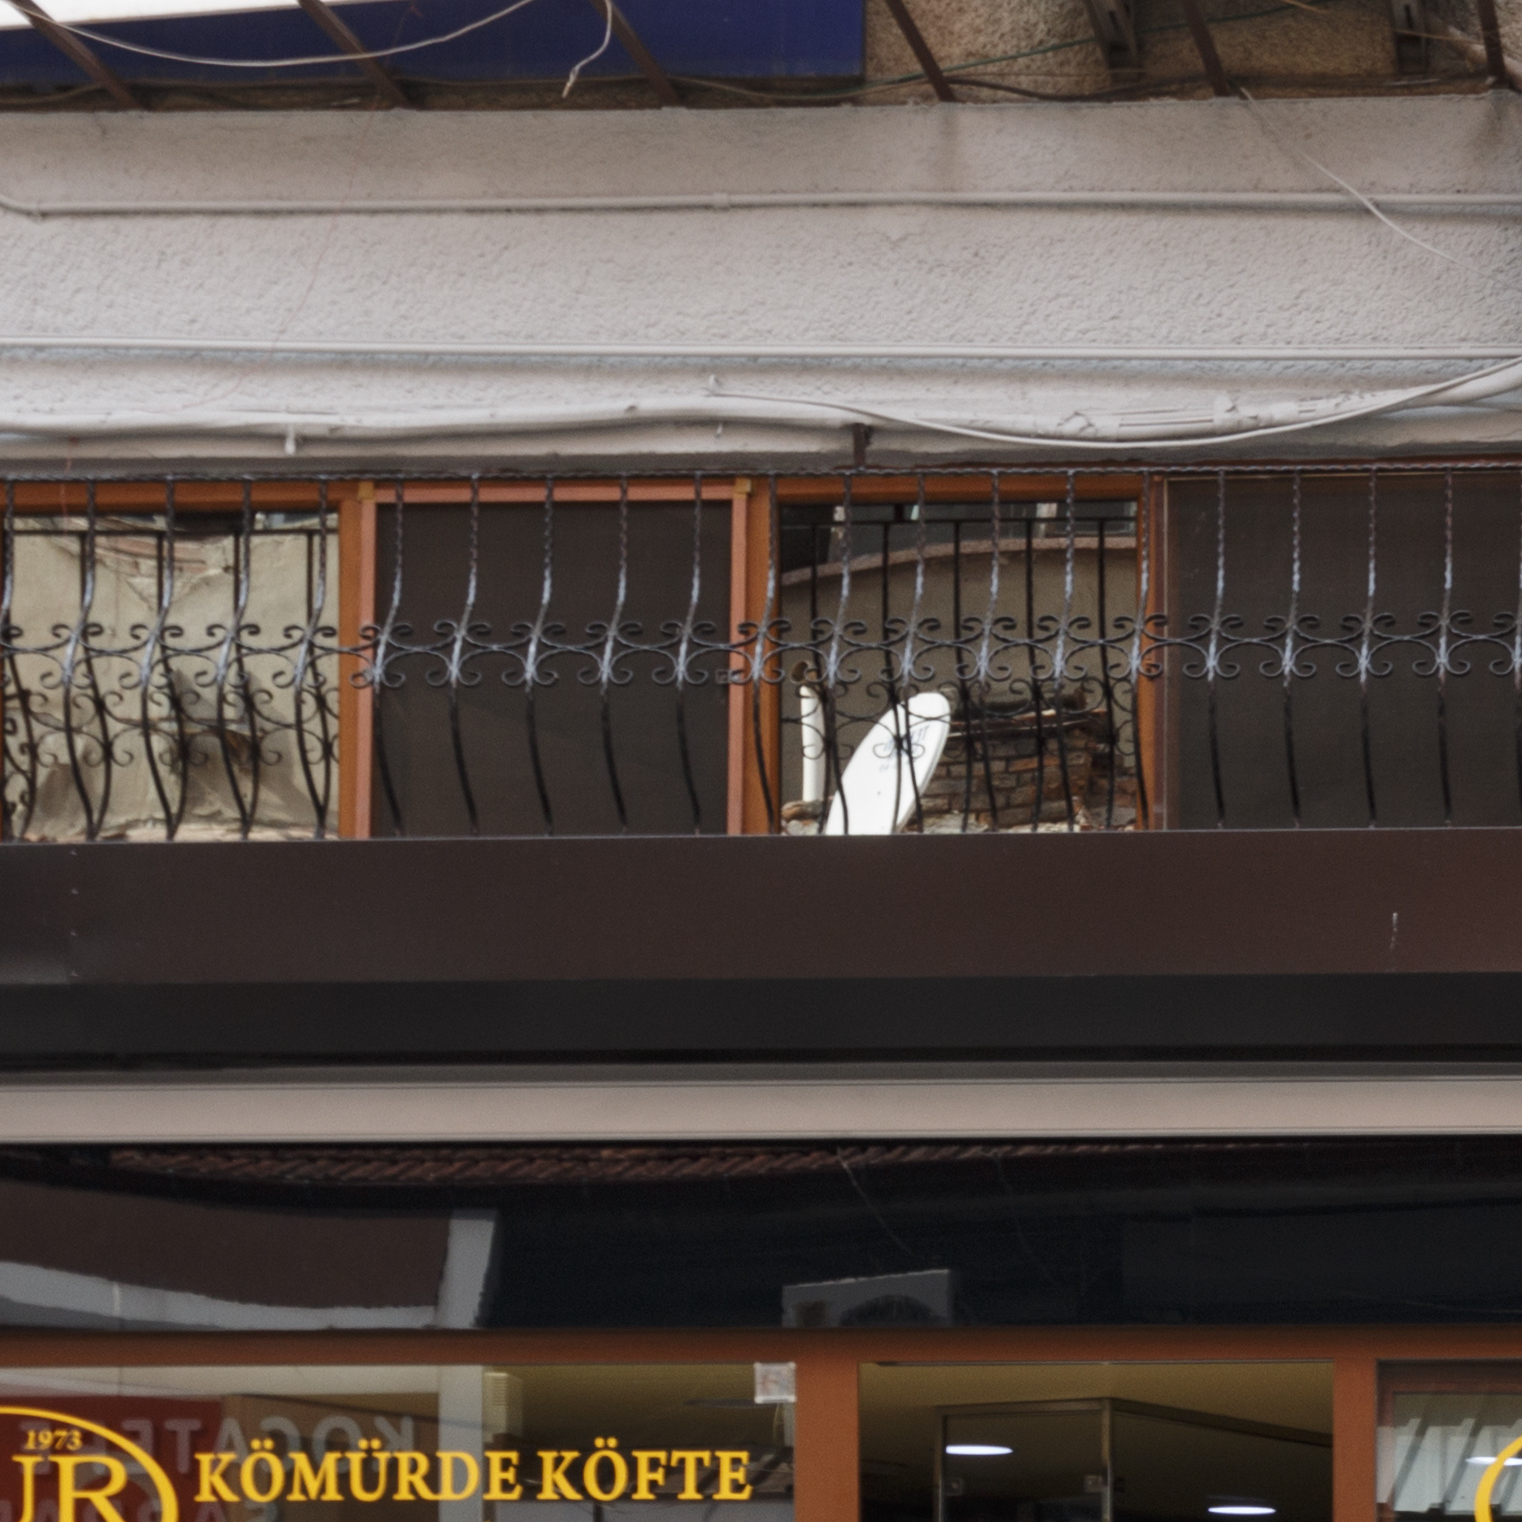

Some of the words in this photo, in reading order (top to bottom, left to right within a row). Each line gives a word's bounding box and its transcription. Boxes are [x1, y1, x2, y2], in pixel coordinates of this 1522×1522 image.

[24, 1429, 83, 1451] 1973
[194, 1438, 523, 1502] KÖMÜRDE
[535, 1436, 754, 1502] KÖFTE
